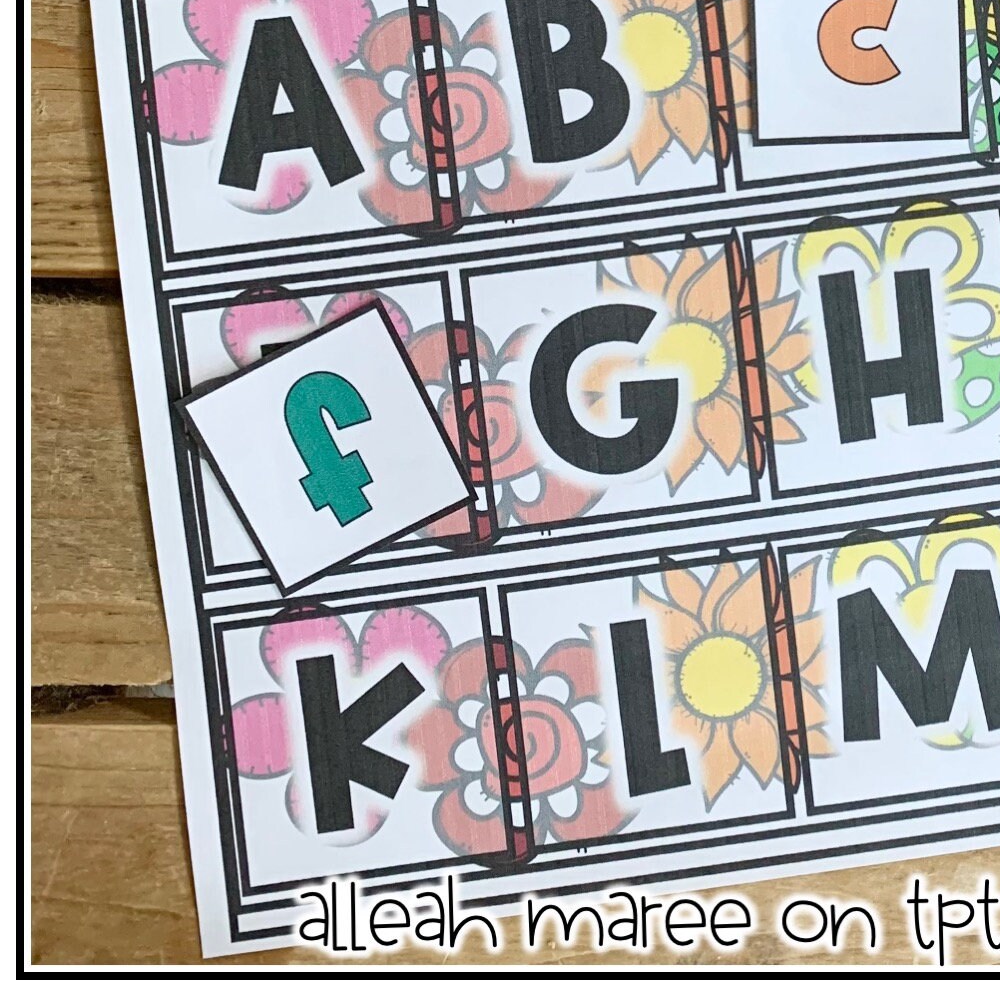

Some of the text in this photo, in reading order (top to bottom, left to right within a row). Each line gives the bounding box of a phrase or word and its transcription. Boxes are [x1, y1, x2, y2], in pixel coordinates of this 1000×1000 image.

[219, 17, 364, 191] A
[530, 304, 678, 474] G
[819, 269, 943, 443] H
[296, 655, 425, 833] K
[610, 619, 690, 797] L
